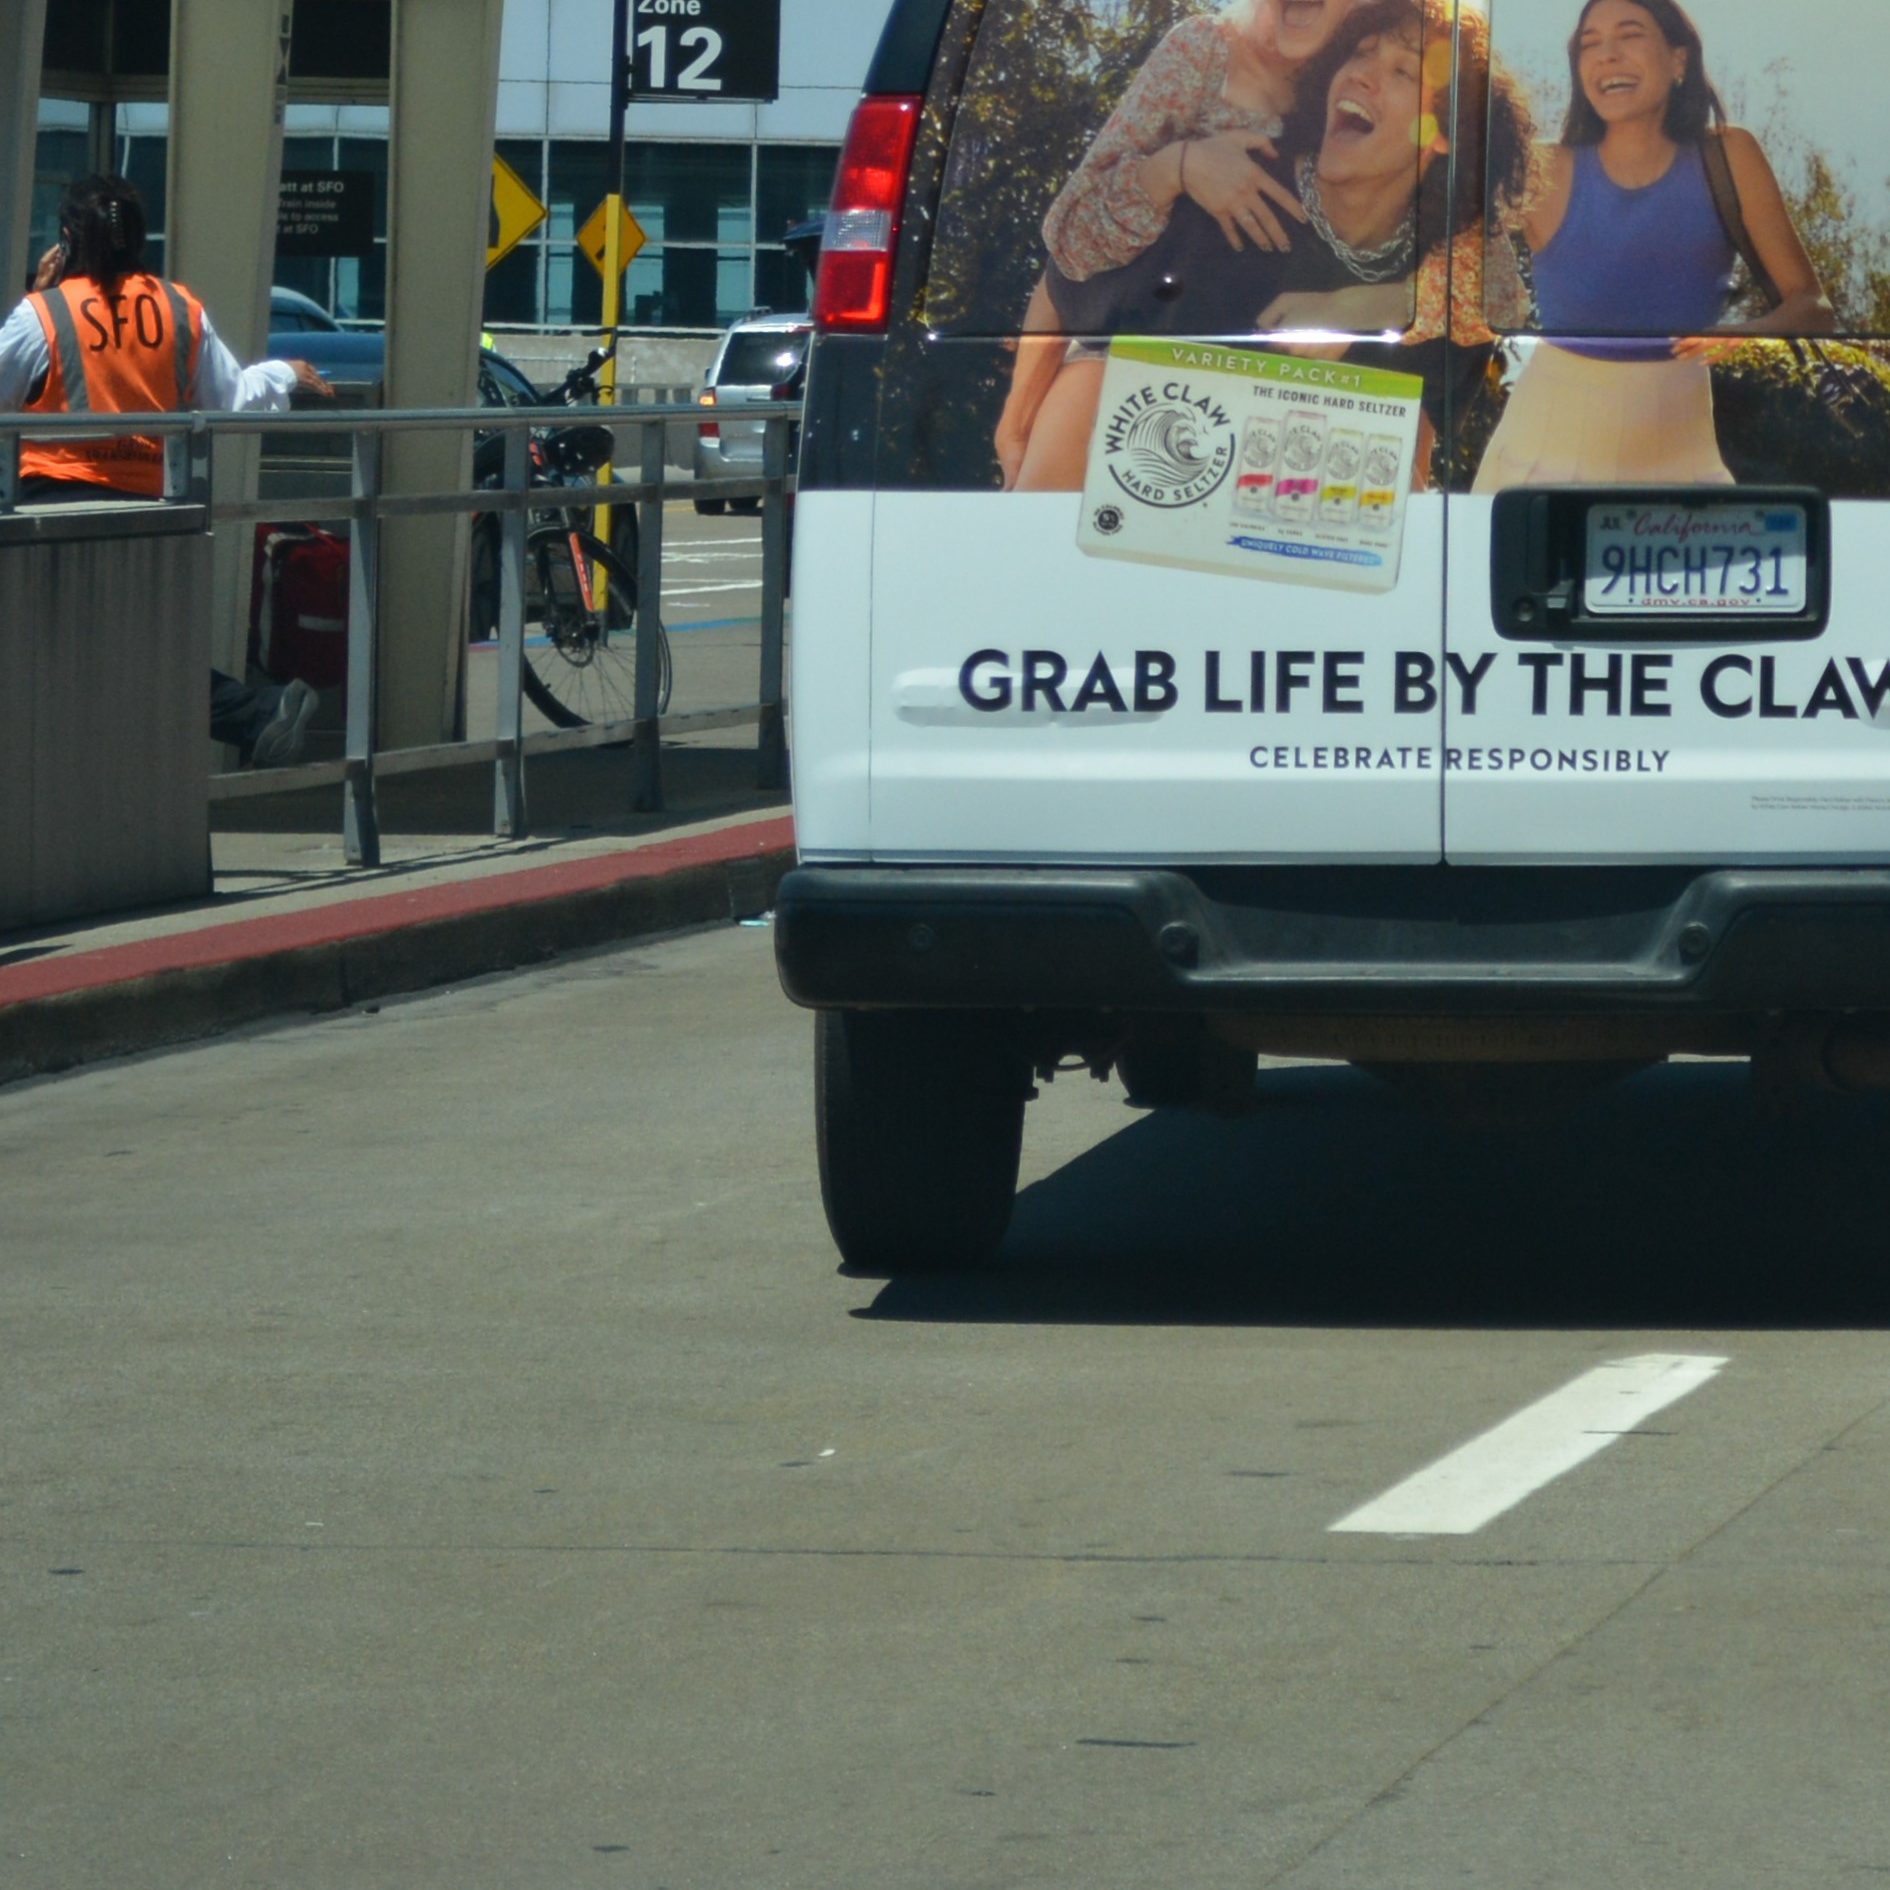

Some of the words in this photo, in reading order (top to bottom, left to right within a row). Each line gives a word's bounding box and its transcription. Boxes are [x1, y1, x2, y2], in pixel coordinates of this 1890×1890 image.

[637, 24, 722, 91] 12
[280, 181, 298, 193] att
[317, 180, 345, 194] SFO
[80, 293, 164, 352] SFO
[1171, 347, 1269, 375] VARIETY
[1253, 384, 1274, 399] THE
[1277, 388, 1321, 406] ICONIC
[1323, 394, 1355, 411] HARD
[1358, 398, 1407, 418] SELTZER
[1105, 385, 1157, 456] WHITE
[1162, 381, 1233, 428] CLAW
[1121, 469, 1166, 502] HARD
[1173, 445, 1230, 501] SELTZER
[1632, 512, 1761, 544] California
[1241, 538, 1284, 552] UNIQUELY
[1286, 544, 1310, 555] COLD
[1310, 548, 1335, 559] WAVE
[1601, 544, 1789, 596] 9HCH731
[1640, 596, 1752, 608] dmv.ca.gov
[957, 648, 1179, 714] GRAB
[1204, 650, 1365, 716] LIFE
[1392, 651, 1501, 717] BY
[1518, 653, 1674, 718] THE
[1249, 744, 1433, 771] CELEBRATE
[1444, 746, 1671, 774] RESPONSIBLY
